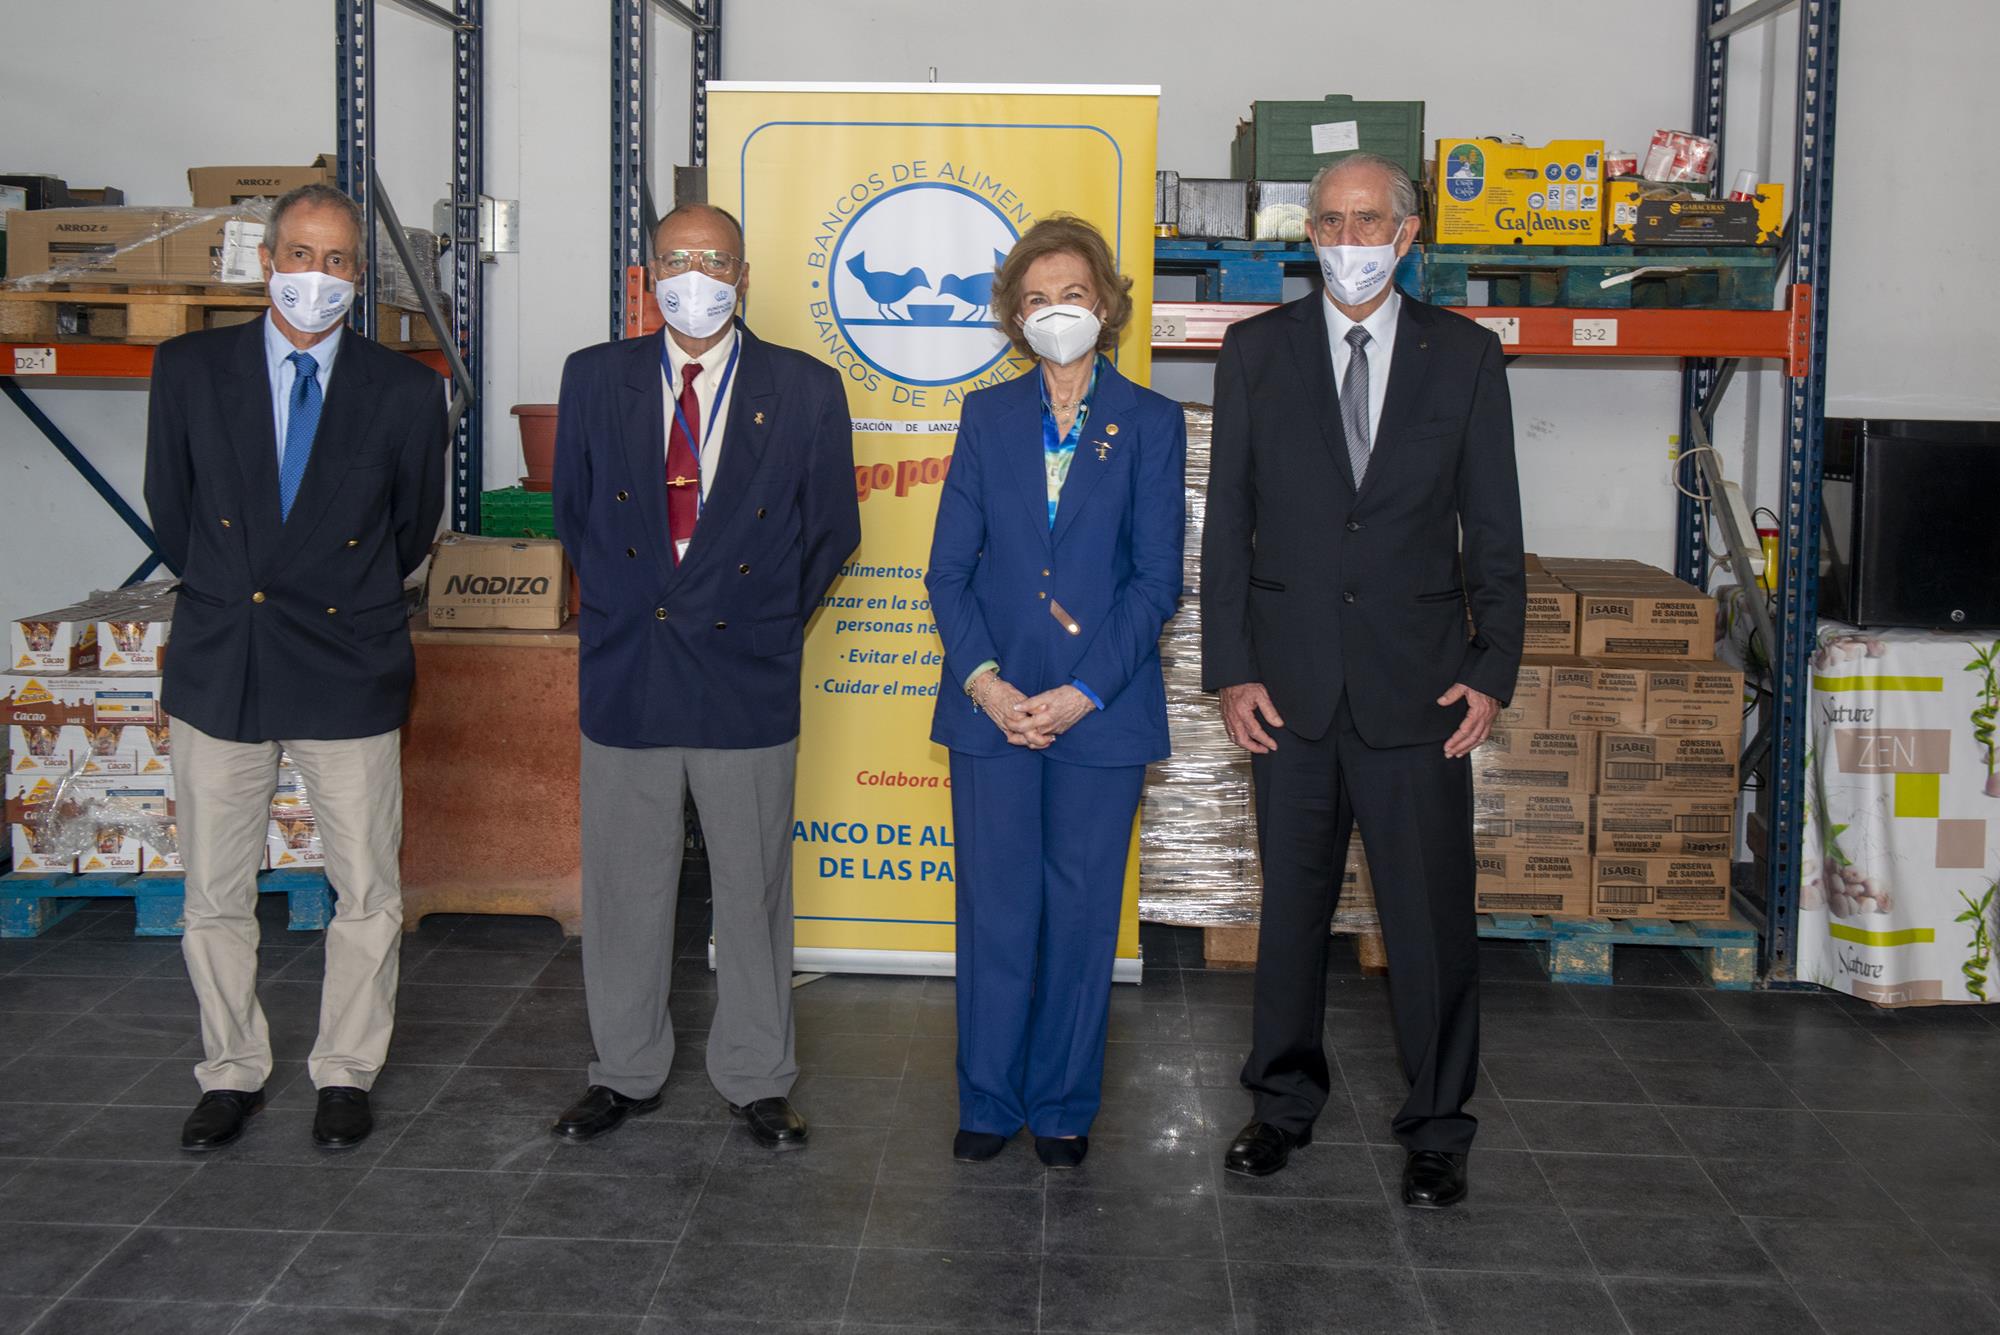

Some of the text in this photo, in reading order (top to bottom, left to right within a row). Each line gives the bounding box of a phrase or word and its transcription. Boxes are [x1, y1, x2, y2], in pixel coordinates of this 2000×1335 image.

[236, 178, 272, 186] ARROZ
[808, 160, 1039, 268] BANCOS DE ALIMEN
[56, 224, 97, 232] ARROZ
[1150, 324, 1176, 337] 2-2
[1574, 328, 1606, 341] E3-2
[810, 300, 881, 392] BANCOS
[892, 385, 927, 407] DE
[16, 357, 45, 369] D2-1
[905, 423, 918, 432] DE
[839, 562, 922, 579] alimentos
[867, 598, 887, 609] en
[891, 595, 907, 610] la
[911, 600, 930, 610] so
[1655, 602, 1696, 610] CONSERVA
[1591, 605, 1630, 616] ISABEL
[836, 620, 937, 634] personas ne
[130, 655, 154, 663] Cacao
[848, 648, 941, 665] Evitar el de
[823, 679, 939, 696] Cuidar el med
[13, 711, 46, 721] Cacao
[1821, 695, 1874, 726] Nature
[1610, 743, 1653, 753] ISABEL
[1858, 735, 1915, 767] ZEN
[856, 770, 939, 788] Colabora
[792, 820, 954, 847] ANCO DE AL
[1528, 856, 1569, 864] CONSERVA
[819, 857, 954, 882] DE LAS PA
[1602, 866, 1643, 876] ISABEL
[1838, 945, 1884, 979] Nature
